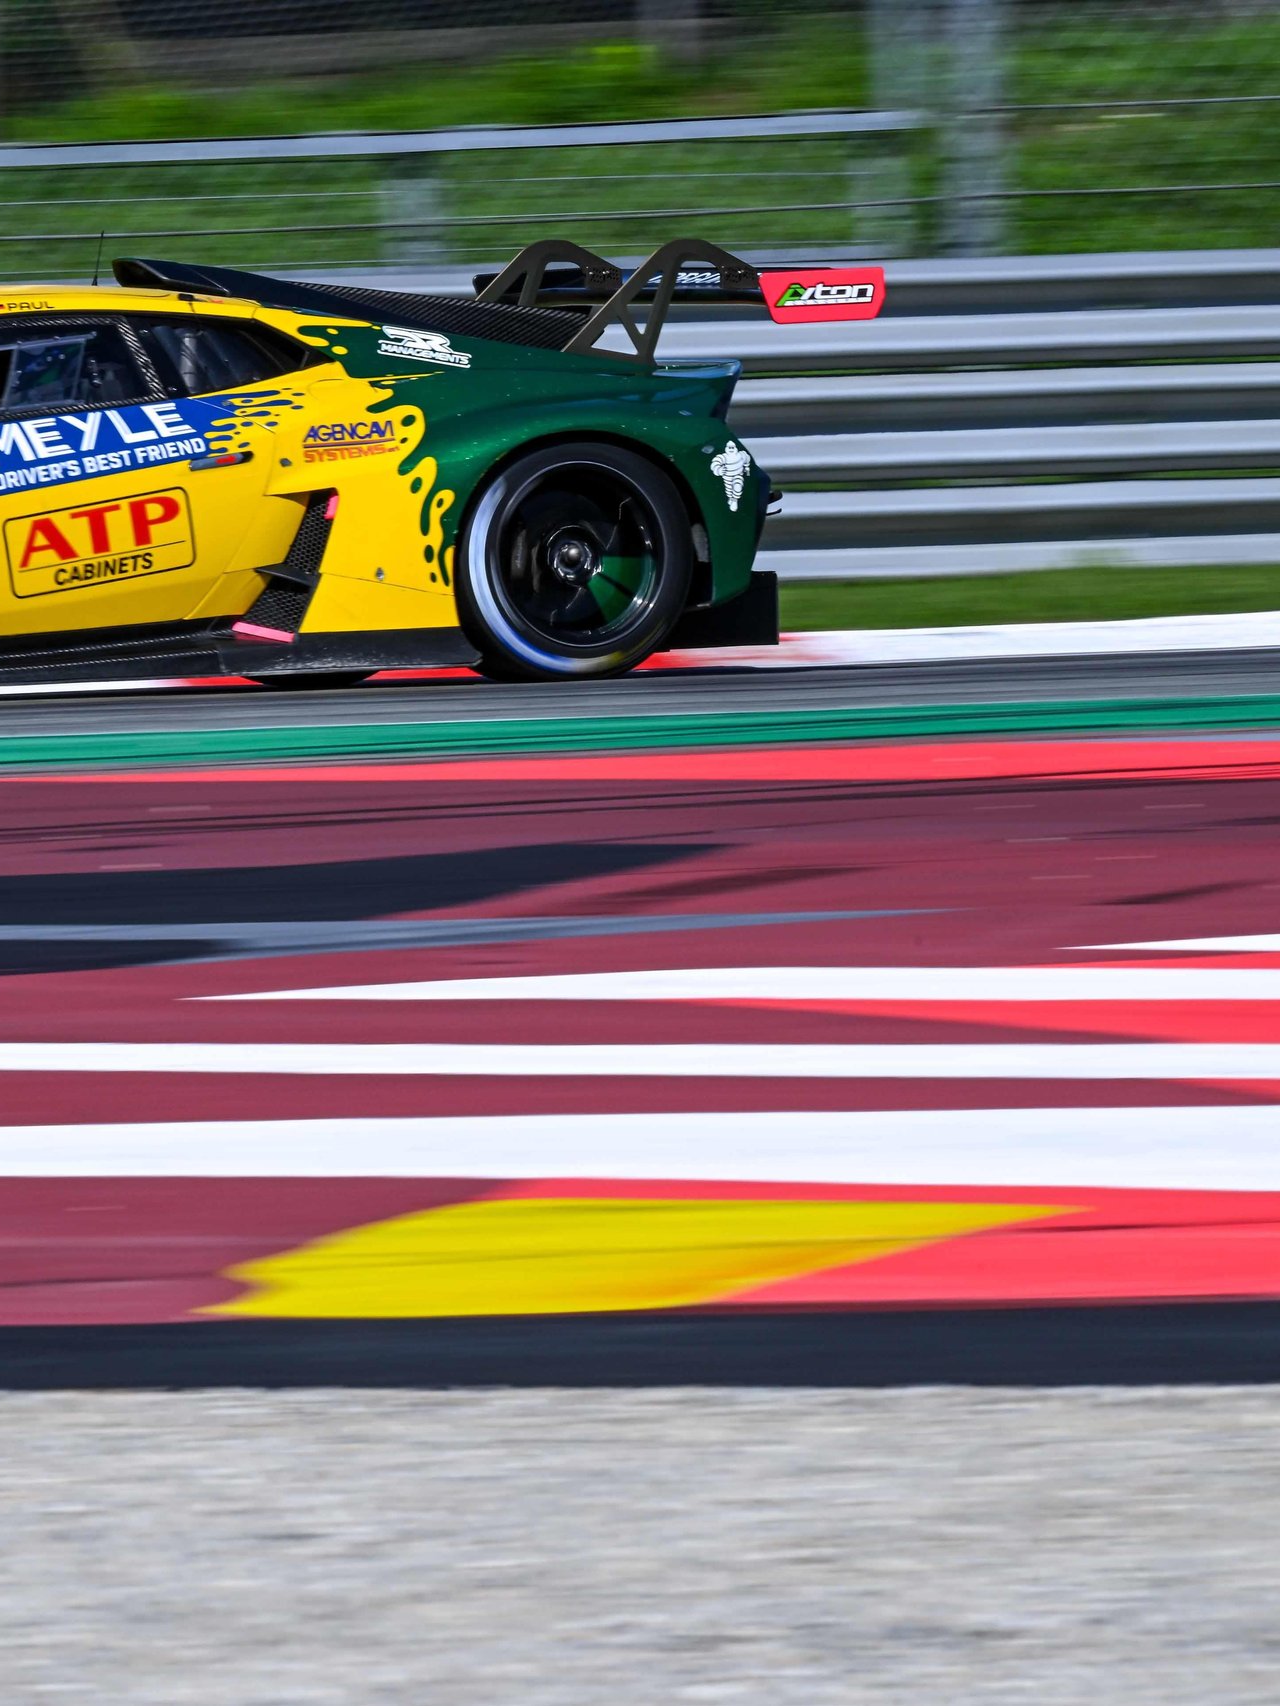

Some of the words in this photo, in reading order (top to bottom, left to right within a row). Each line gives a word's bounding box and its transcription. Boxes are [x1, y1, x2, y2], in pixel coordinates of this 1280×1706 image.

[6, 301, 55, 311] PAUL
[381, 343, 469, 365] MANAGEMENTS
[84, 449, 132, 474] BEST
[133, 437, 207, 464] FRIEND
[19, 496, 180, 569] ATP
[54, 552, 153, 586] CABINETS
